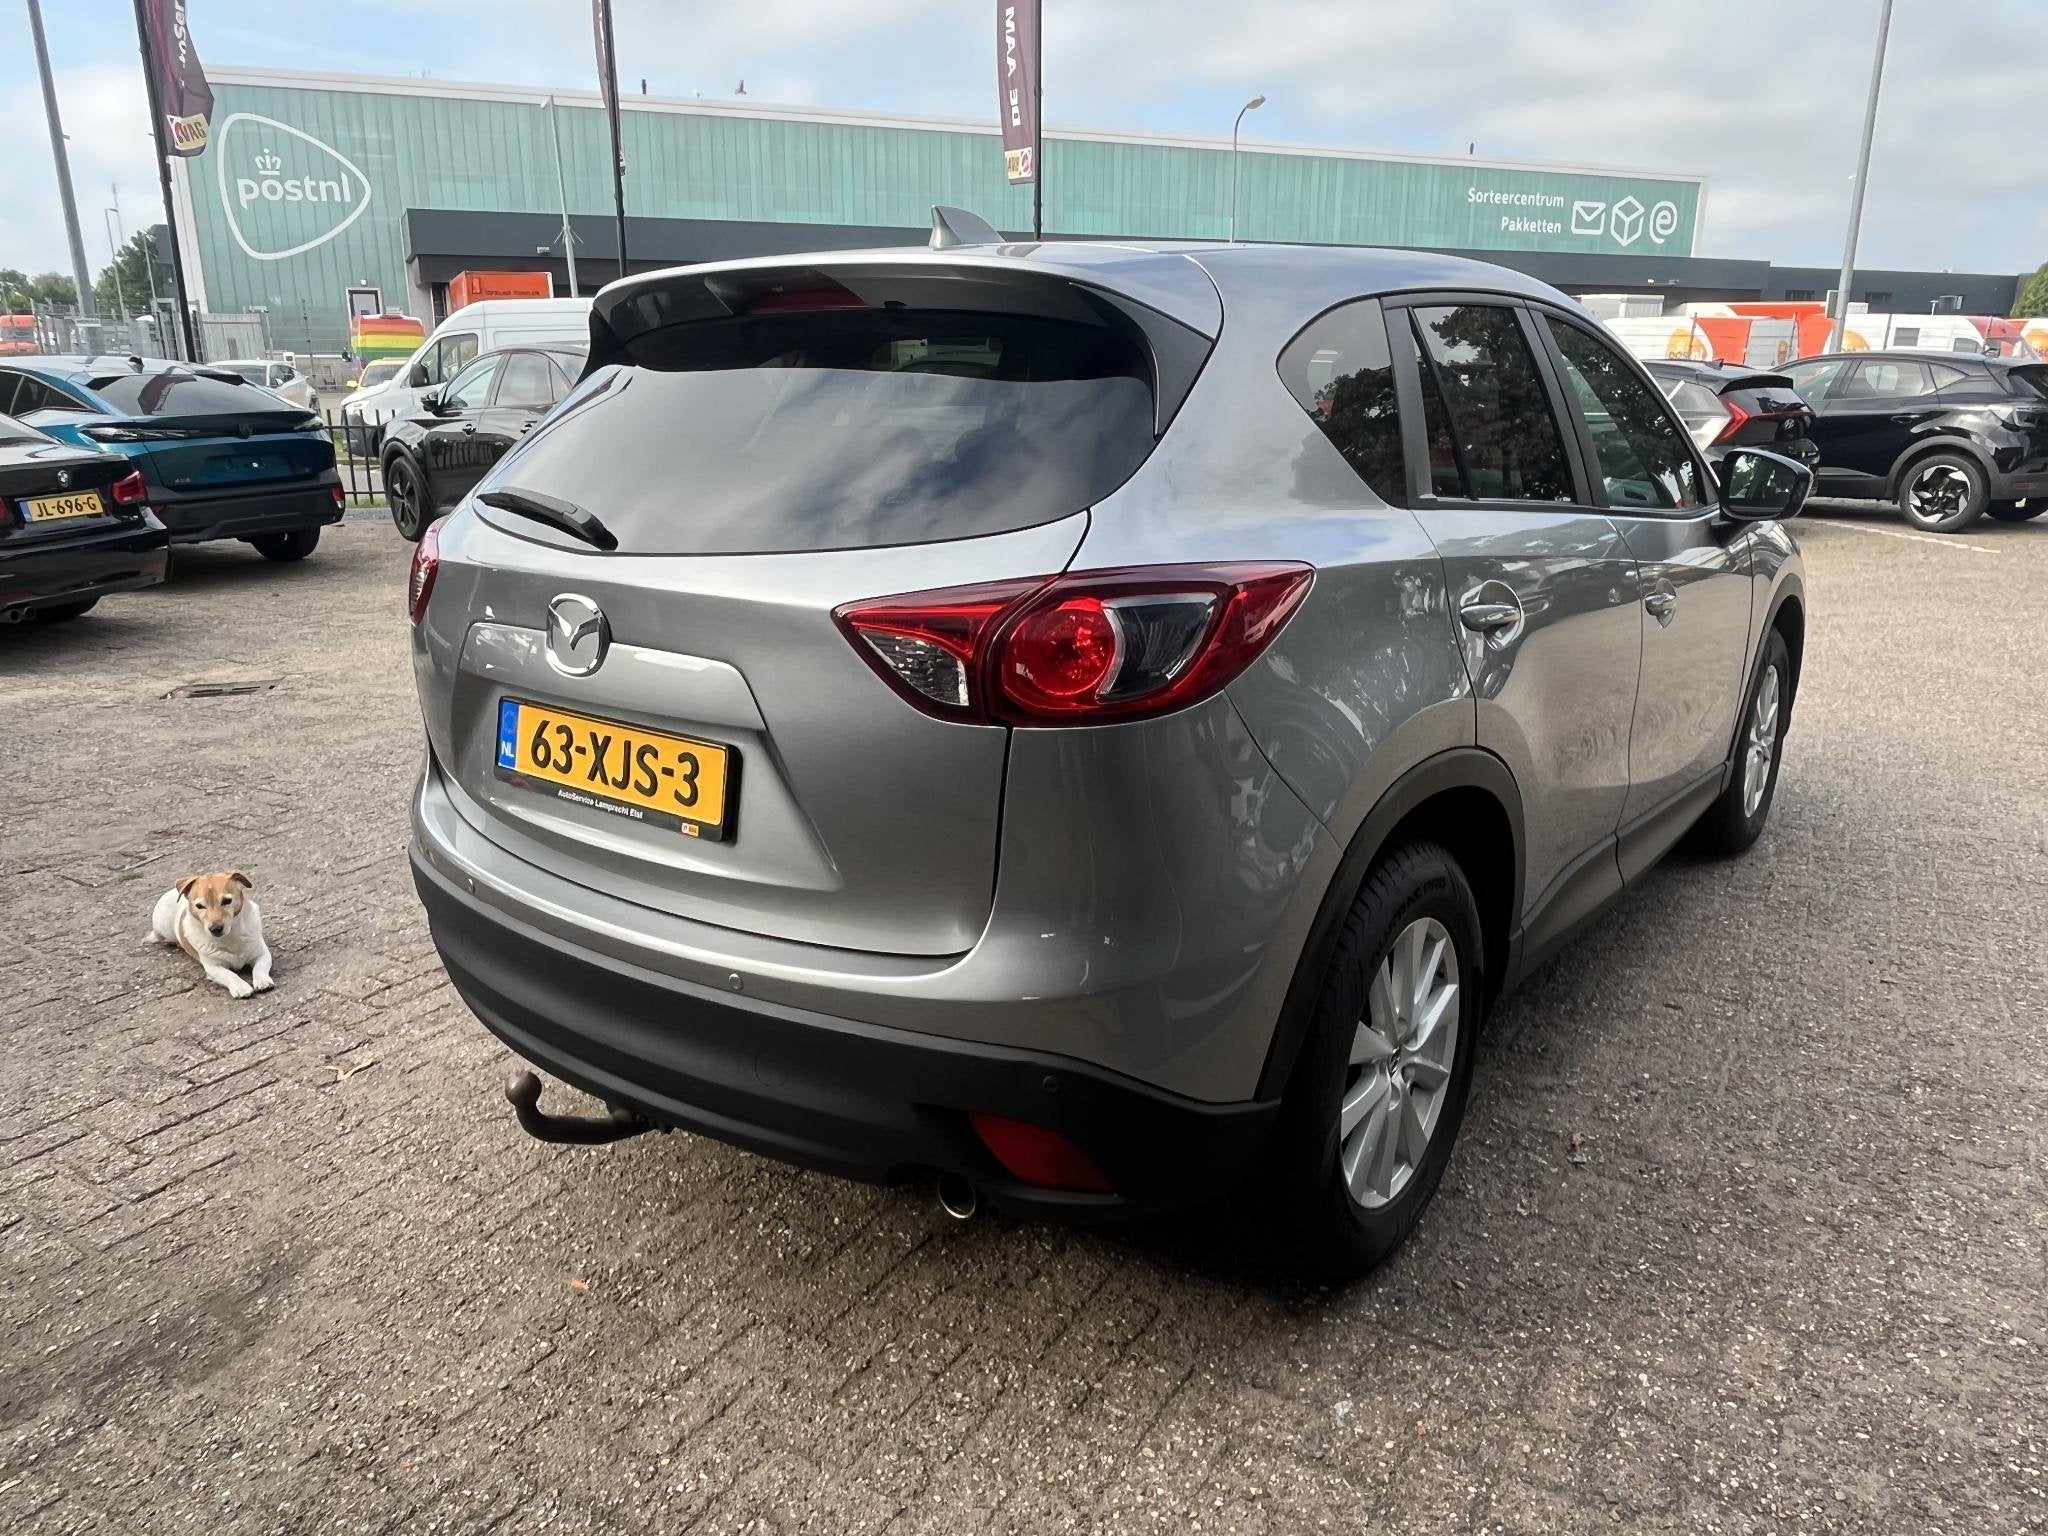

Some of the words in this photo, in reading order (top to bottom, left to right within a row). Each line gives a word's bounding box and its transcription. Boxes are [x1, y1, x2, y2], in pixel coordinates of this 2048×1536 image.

[236, 171, 351, 210] postnl
[1467, 187, 1565, 208] Sorteercentrum
[1500, 216, 1562, 234] Pakketten
[37, 496, 97, 518] JL-696-G
[500, 741, 515, 758] NL
[530, 719, 700, 808] 63-XJS-3
